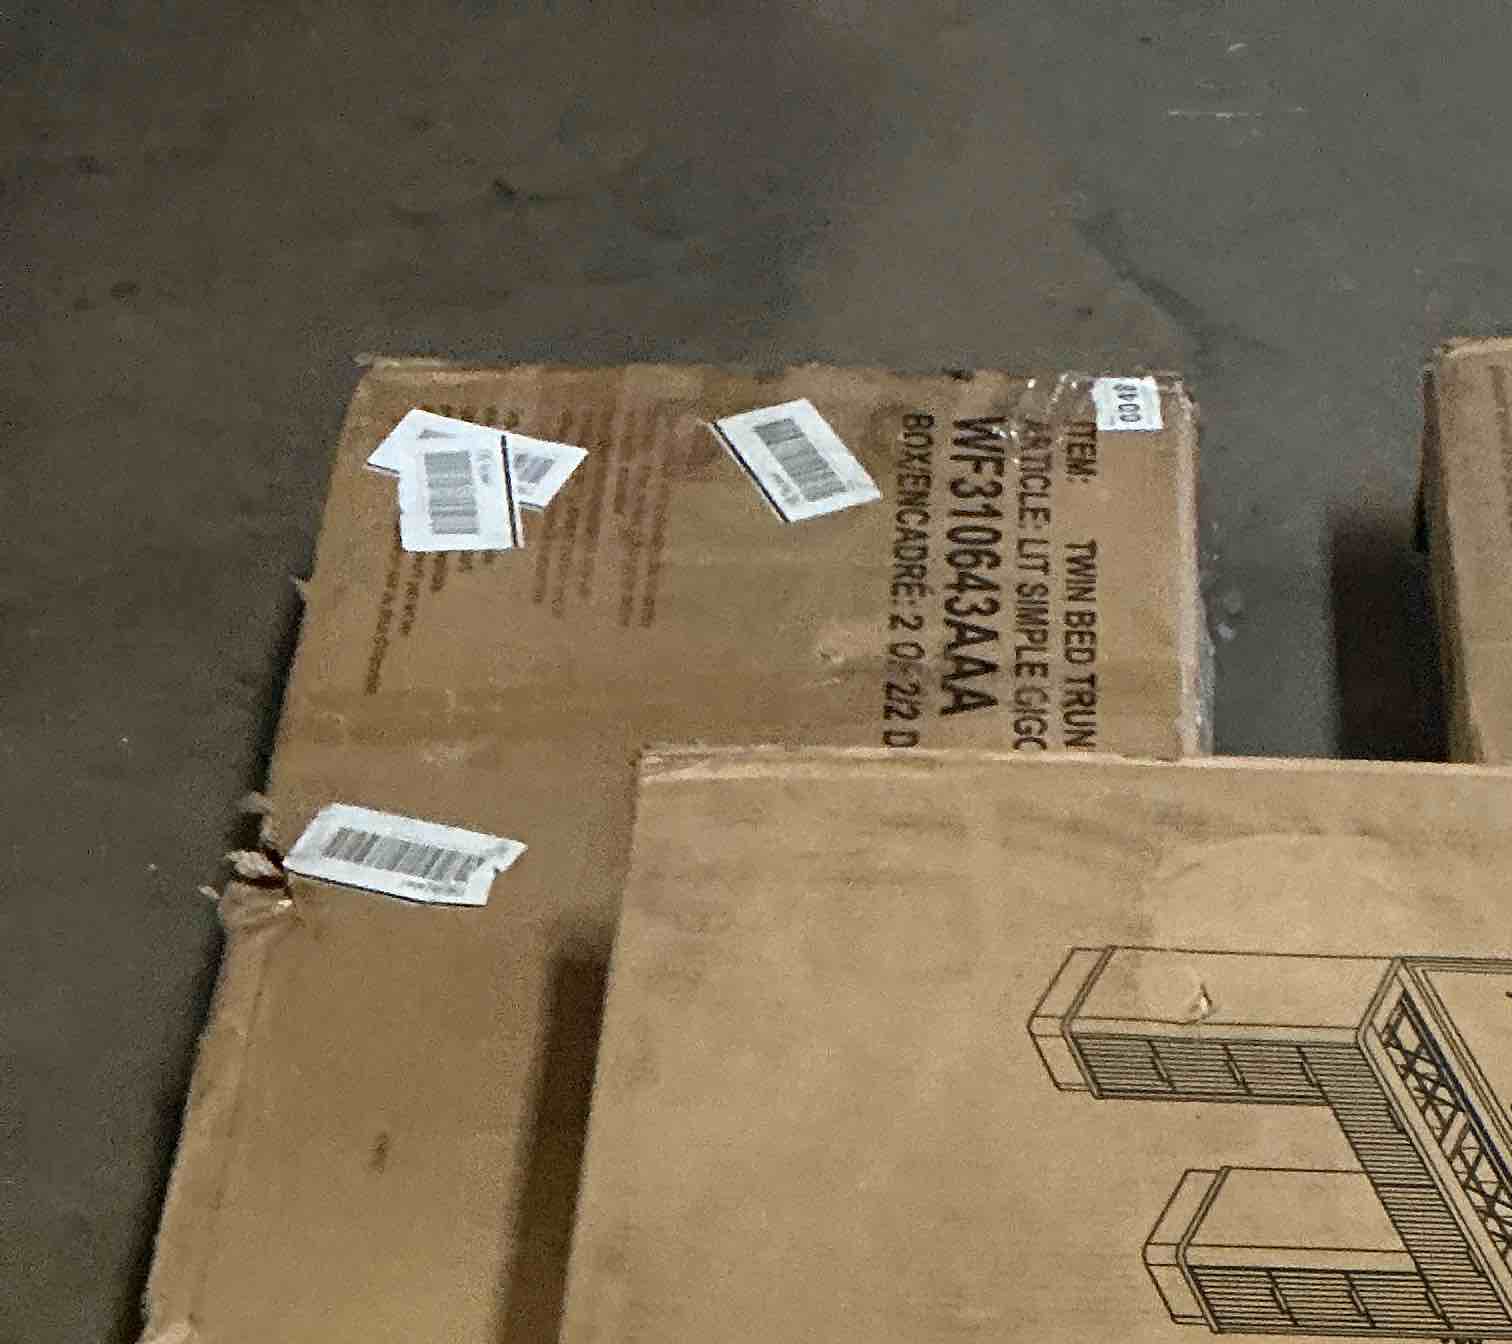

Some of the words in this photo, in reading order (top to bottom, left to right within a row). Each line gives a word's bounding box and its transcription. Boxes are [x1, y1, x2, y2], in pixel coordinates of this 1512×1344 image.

[1064, 420, 1097, 484] ITEM:
[940, 415, 1008, 716] WF310643AAA
[1016, 537, 1050, 577] LIT
[1064, 538, 1097, 603] TWIN
[888, 614, 924, 631] 2
[1015, 582, 1049, 679] SIMPLE
[1063, 610, 1097, 665] BED
